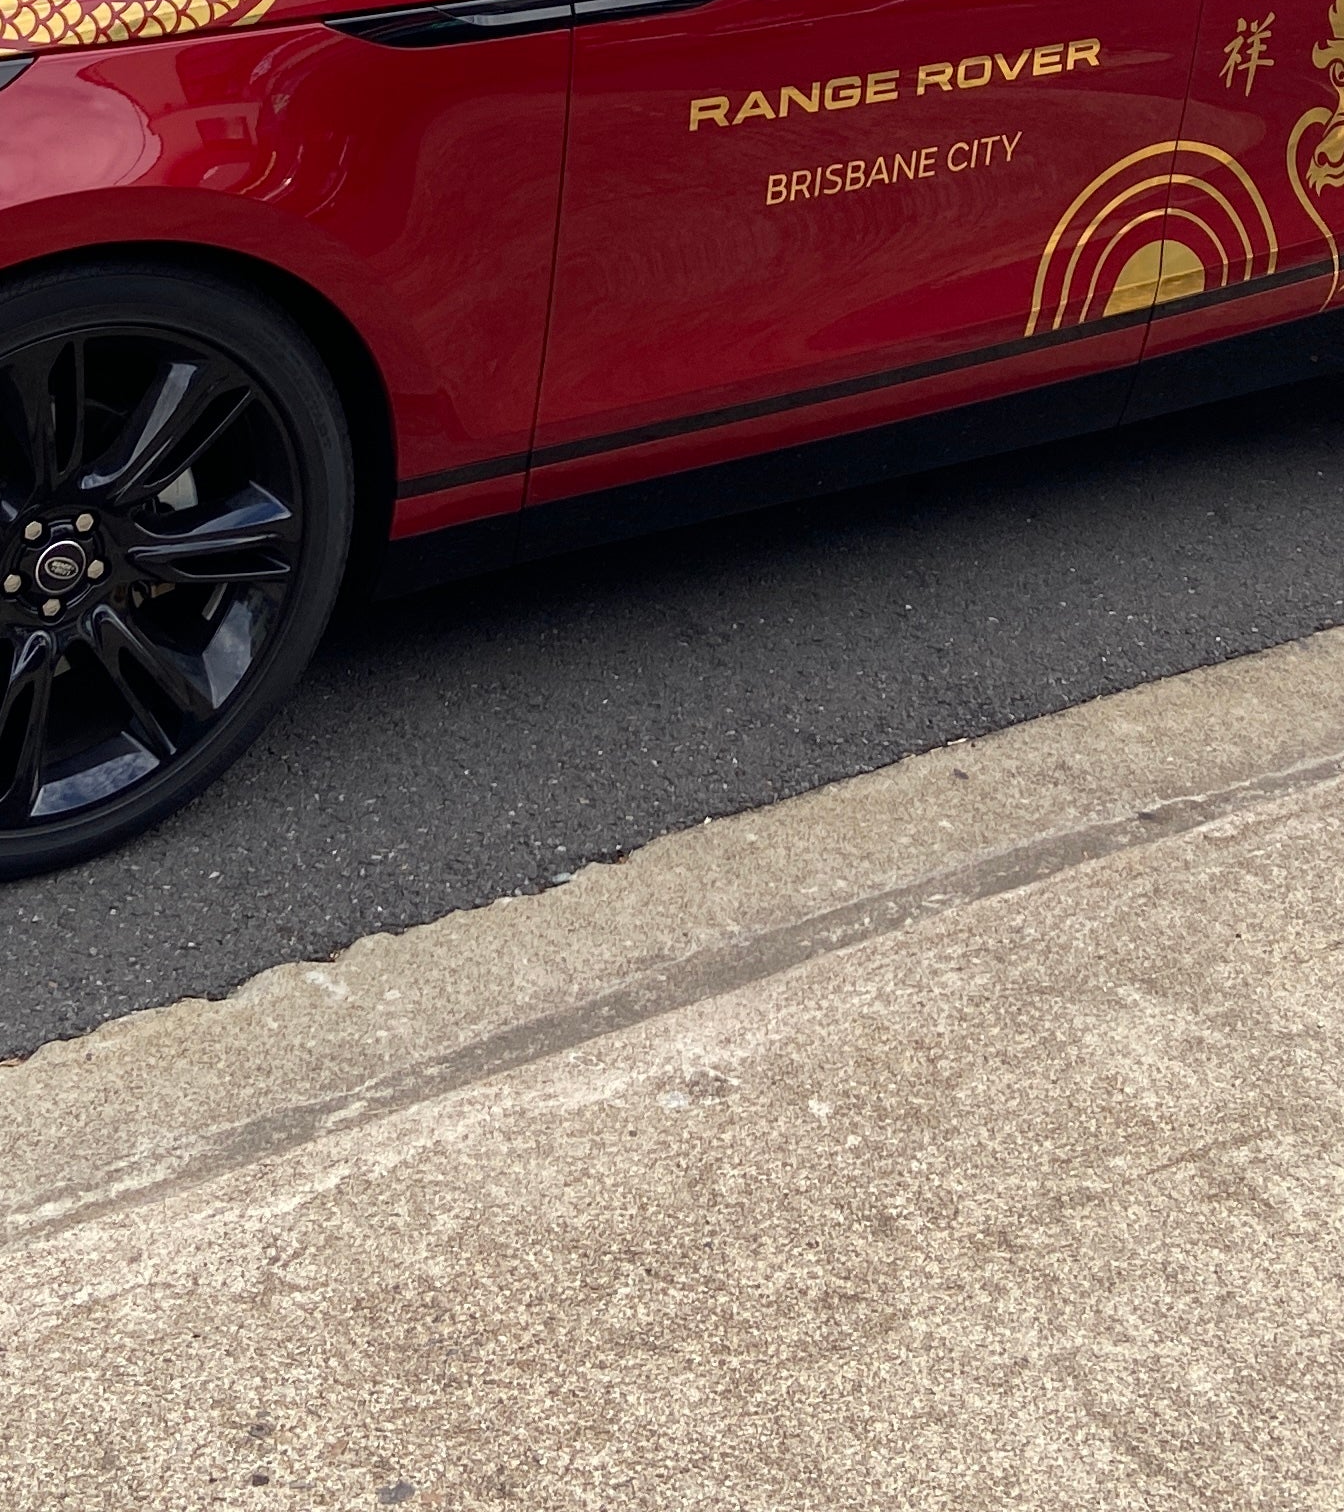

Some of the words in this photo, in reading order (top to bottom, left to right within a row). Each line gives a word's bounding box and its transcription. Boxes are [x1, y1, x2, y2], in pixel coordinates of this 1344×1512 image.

[688, 69, 901, 132] RANGE
[916, 37, 1102, 96] ROVER
[765, 146, 939, 206] BRISBANE
[946, 131, 1023, 173] CITY
